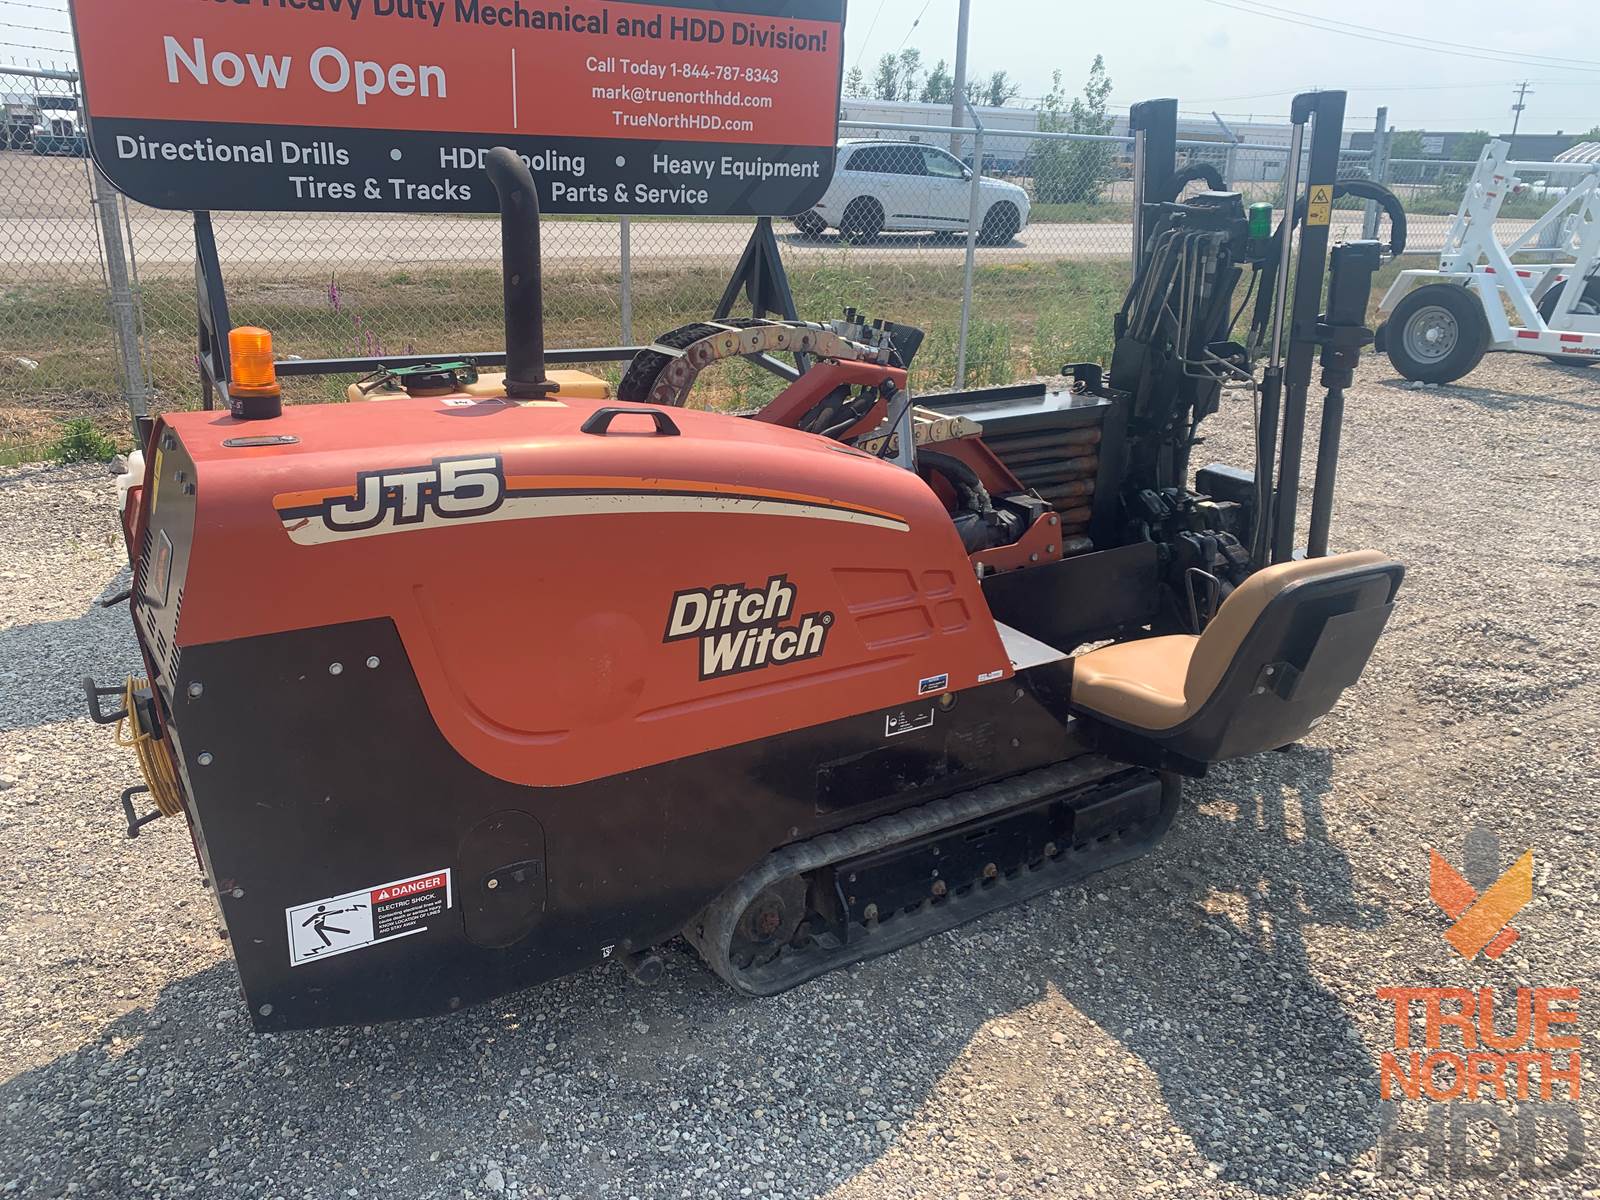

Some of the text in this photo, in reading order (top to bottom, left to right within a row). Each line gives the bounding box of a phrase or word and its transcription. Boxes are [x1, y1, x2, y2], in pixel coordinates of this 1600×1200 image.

[374, 0, 446, 27] Duty
[455, 1, 608, 35] Mechanical
[615, 14, 661, 39] and
[669, 17, 725, 44] HDD
[732, 23, 827, 52] Division!
[163, 35, 447, 105] Now Open
[586, 56, 779, 83] Call Today 1-844-787-8343
[591, 85, 772, 108] mark@truenorthhdd.com
[613, 111, 753, 132] TrueNorthHDD.com
[115, 134, 350, 165] Directional Drills
[513, 148, 585, 177] ooling
[652, 153, 819, 180] Heavy Equipment
[288, 175, 472, 200] Tires & Tracks
[552, 182, 708, 204] Parts & Service
[667, 578, 793, 638] Ditch
[392, 878, 440, 897] DANGER
[378, 900, 410, 912] ELECTRIC
